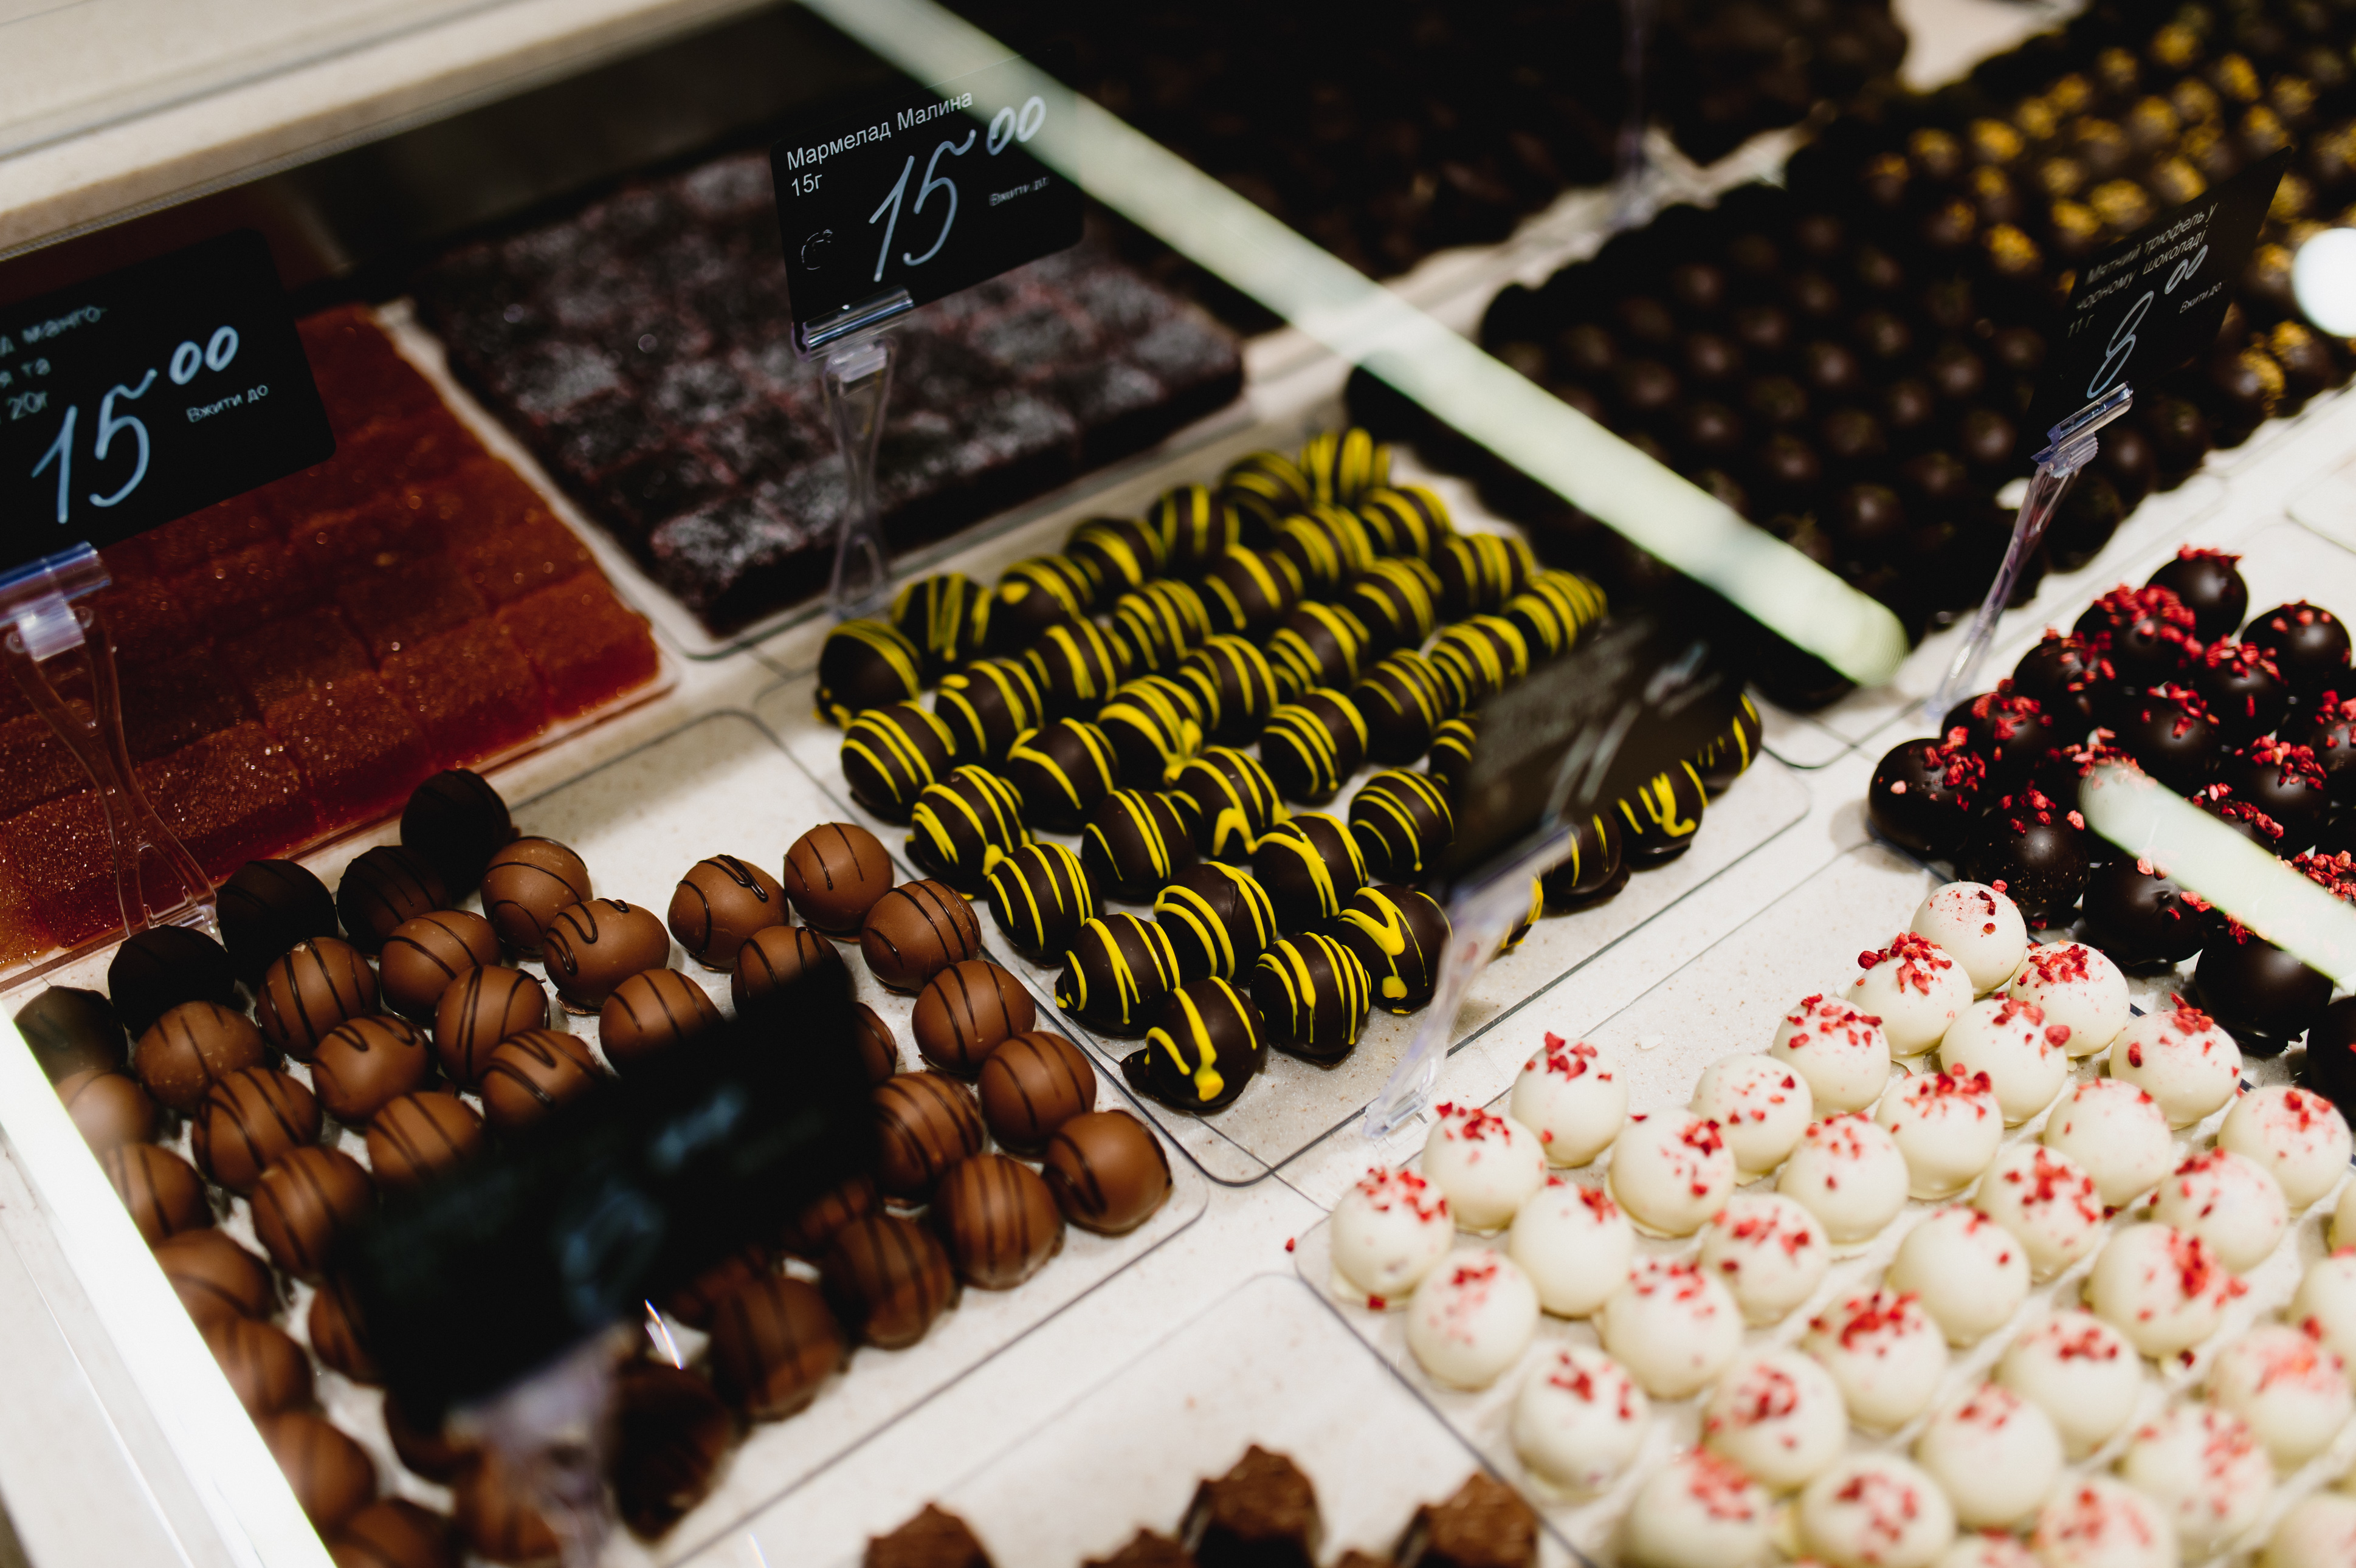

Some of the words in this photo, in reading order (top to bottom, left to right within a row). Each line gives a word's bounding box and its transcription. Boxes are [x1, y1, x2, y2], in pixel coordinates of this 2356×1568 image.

[787, 121, 892, 171] Мармелад
[897, 92, 974, 131] Малина
[791, 174, 823, 197] 15г
[2076, 269, 2138, 311] чорному
[2142, 225, 2208, 275] шоколаді
[2085, 244, 2141, 286] Мятний
[2144, 211, 2205, 256] трюфель
[2205, 202, 2219, 223] у
[186, 394, 243, 424] Вжити
[247, 384, 269, 404] до
